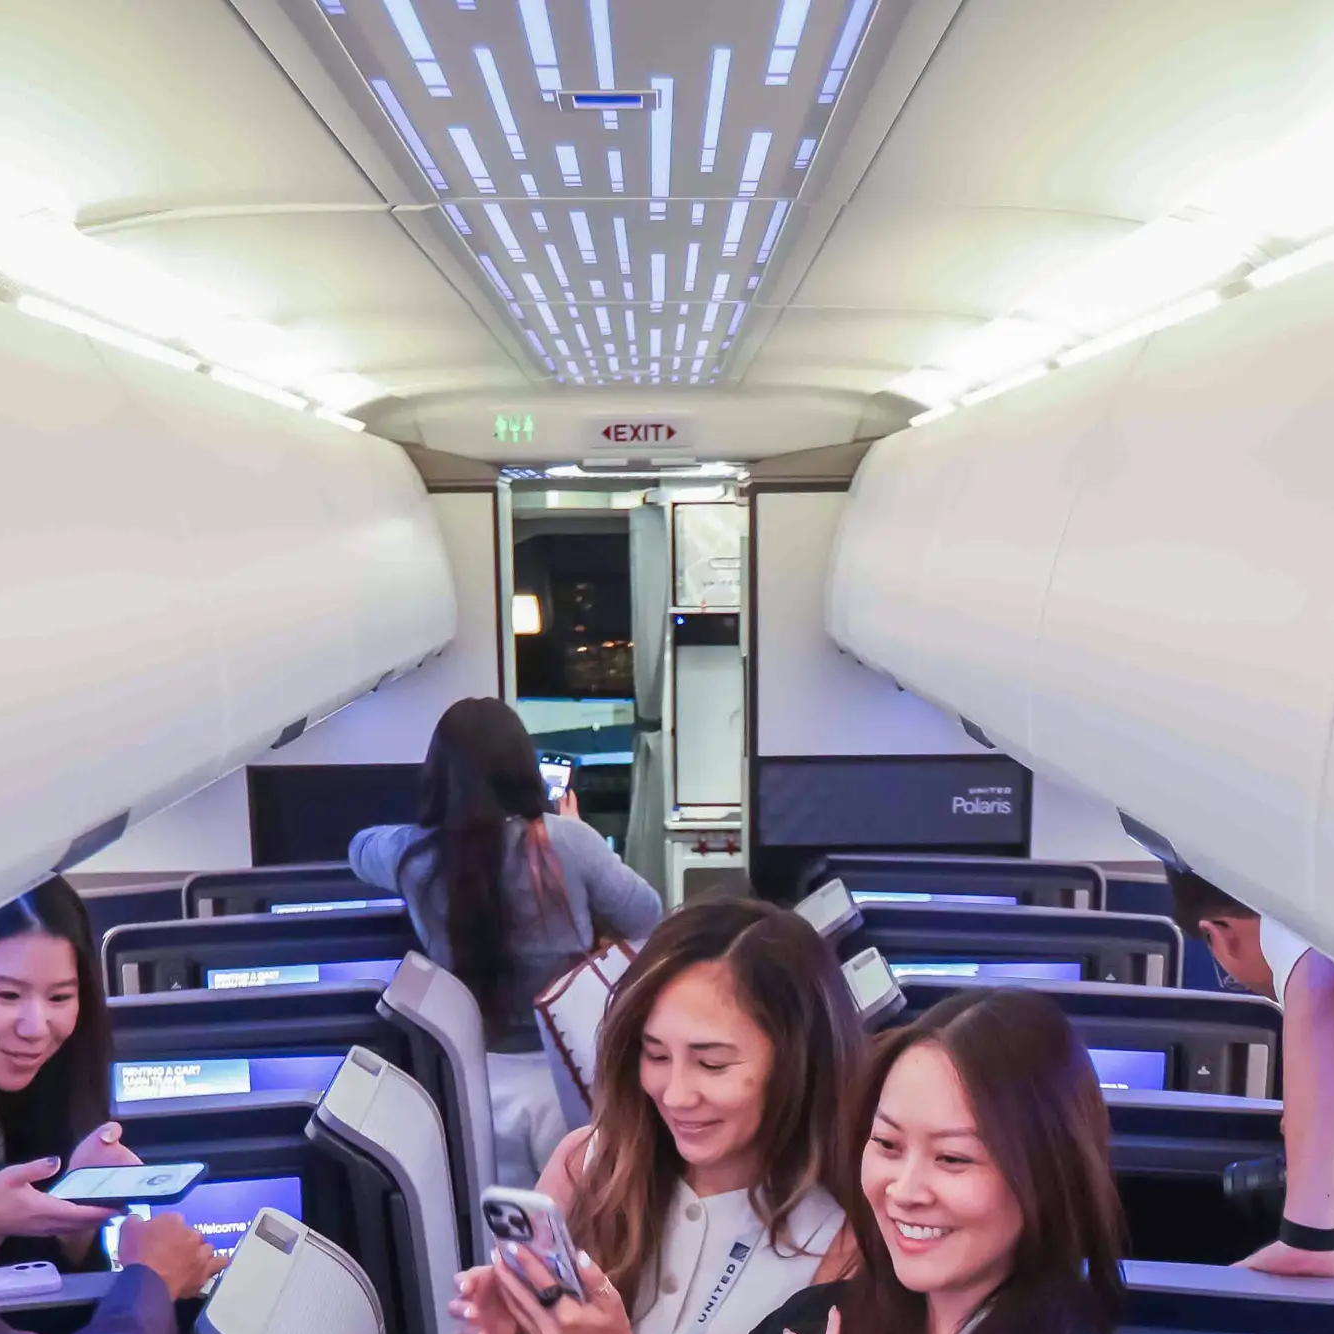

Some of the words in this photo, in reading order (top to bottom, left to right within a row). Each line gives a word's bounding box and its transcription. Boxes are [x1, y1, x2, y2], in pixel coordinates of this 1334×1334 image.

[613, 423, 664, 441] EXIT
[952, 796, 1012, 814] Polaris
[697, 1263, 736, 1323] UNITED
